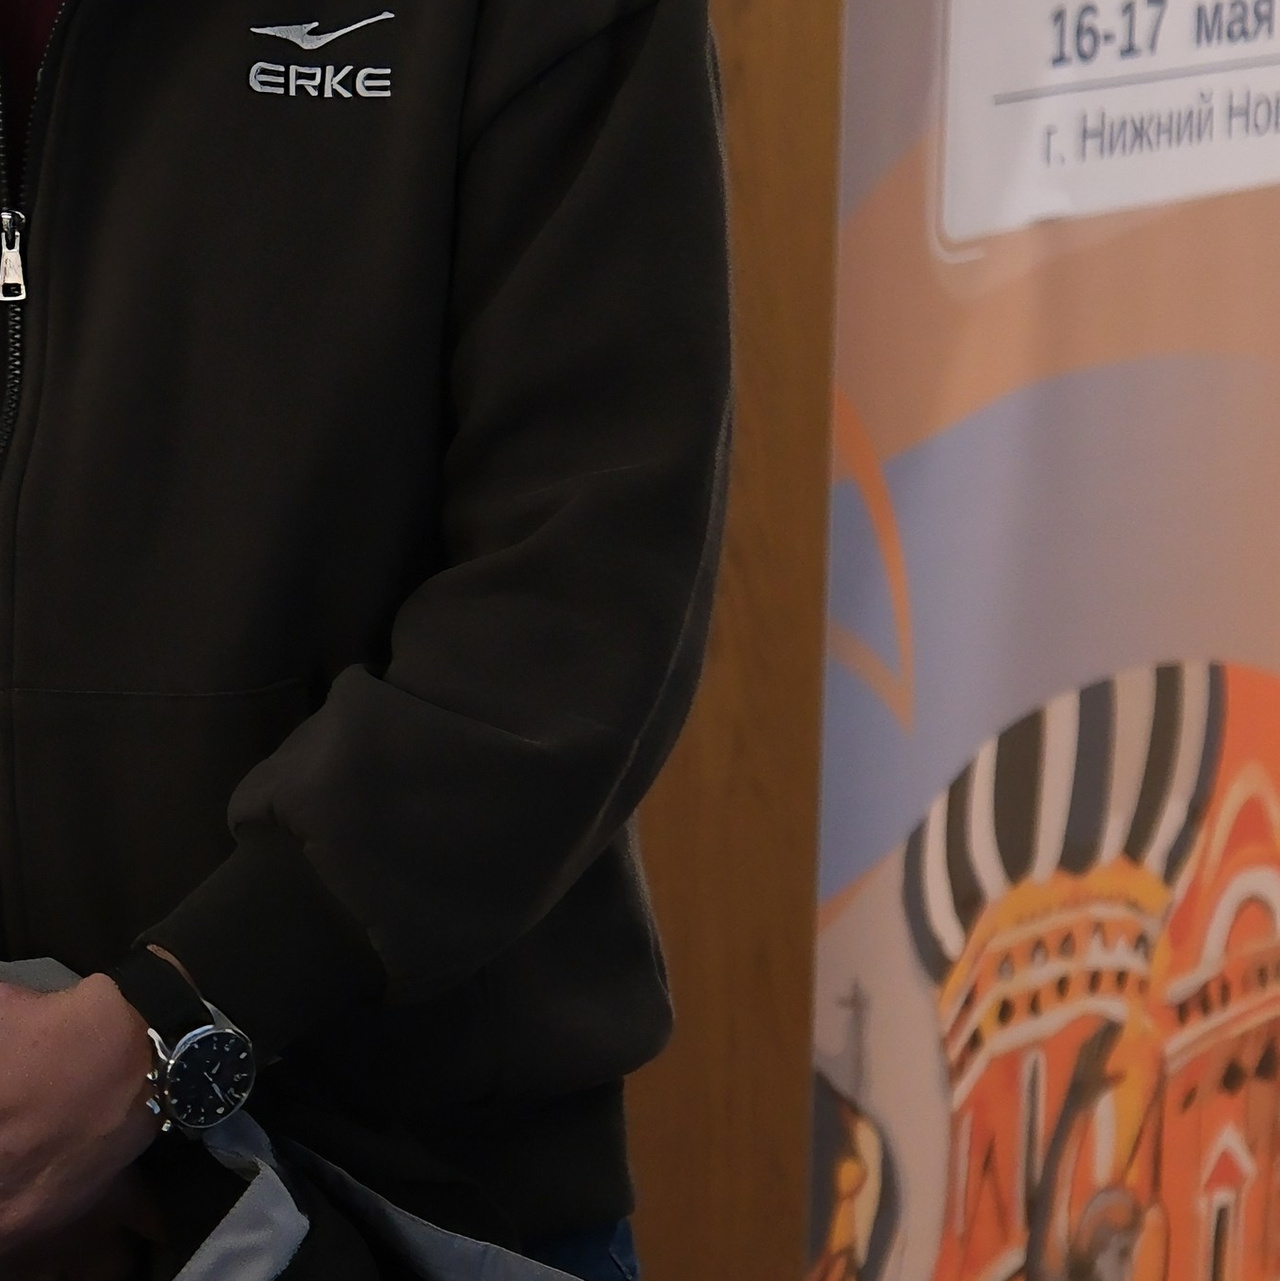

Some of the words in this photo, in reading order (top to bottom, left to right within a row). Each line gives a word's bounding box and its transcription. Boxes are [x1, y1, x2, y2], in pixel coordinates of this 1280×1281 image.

[248, 61, 392, 98] ERKE
[1043, 124, 1066, 167] г.
[1080, 90, 1214, 161] Нижний
